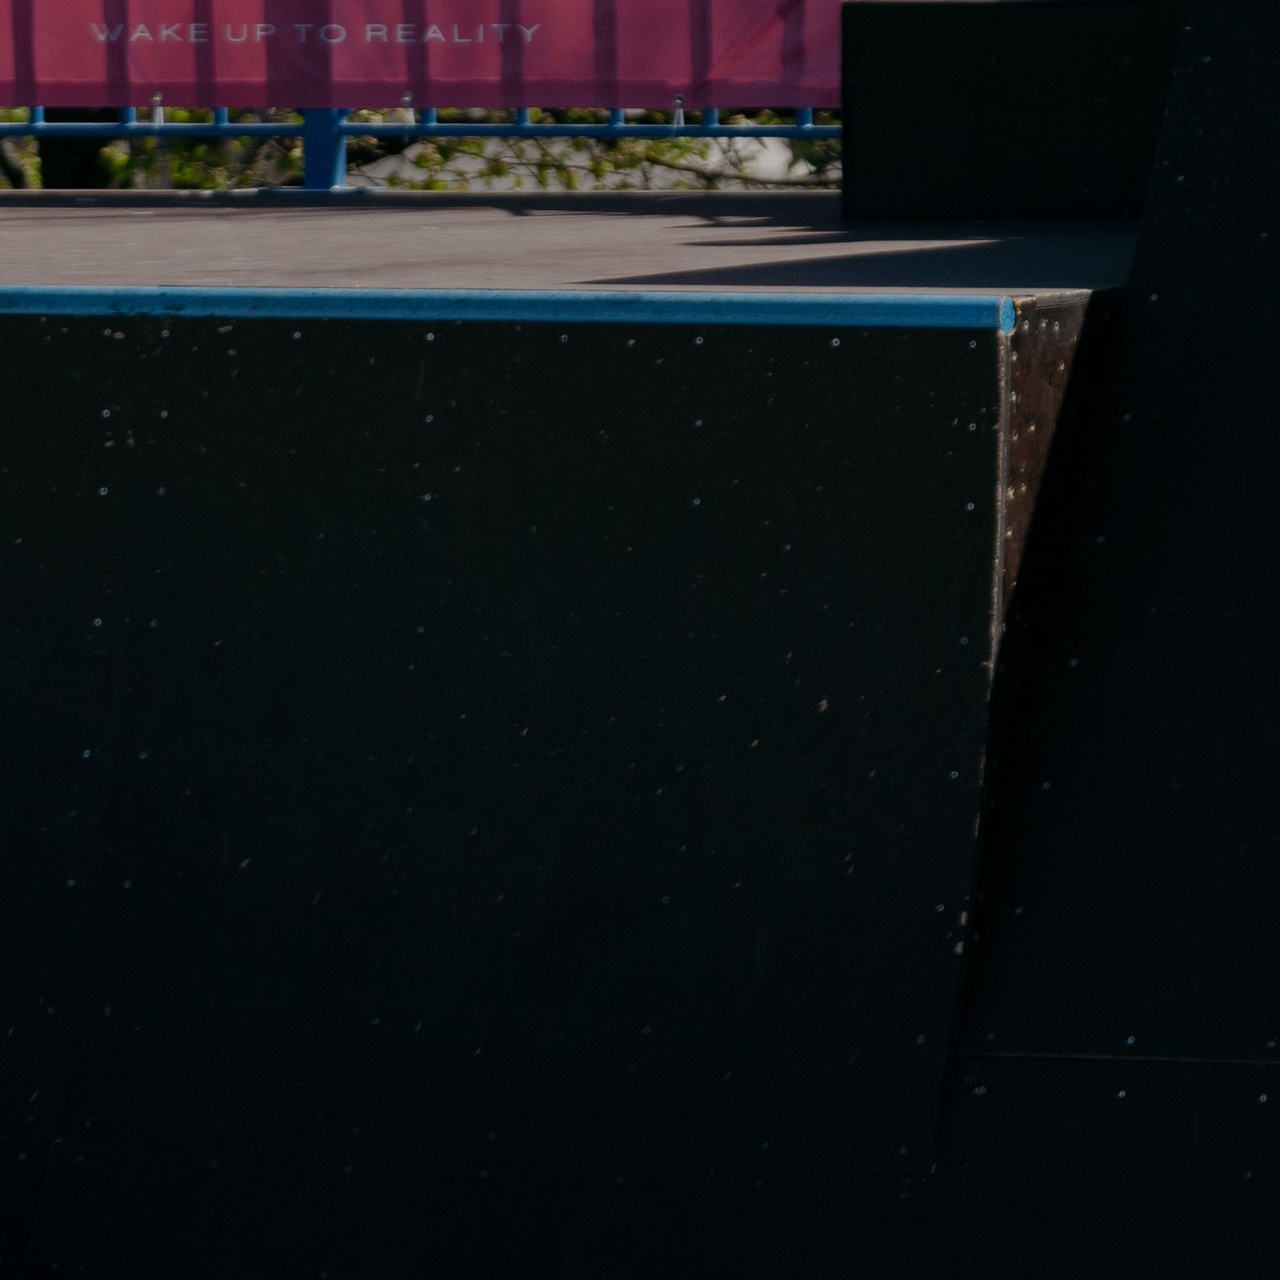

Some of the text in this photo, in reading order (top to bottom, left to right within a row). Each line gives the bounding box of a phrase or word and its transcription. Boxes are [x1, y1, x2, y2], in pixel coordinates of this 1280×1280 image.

[90, 23, 541, 43] WAKE UP TO REALITY
